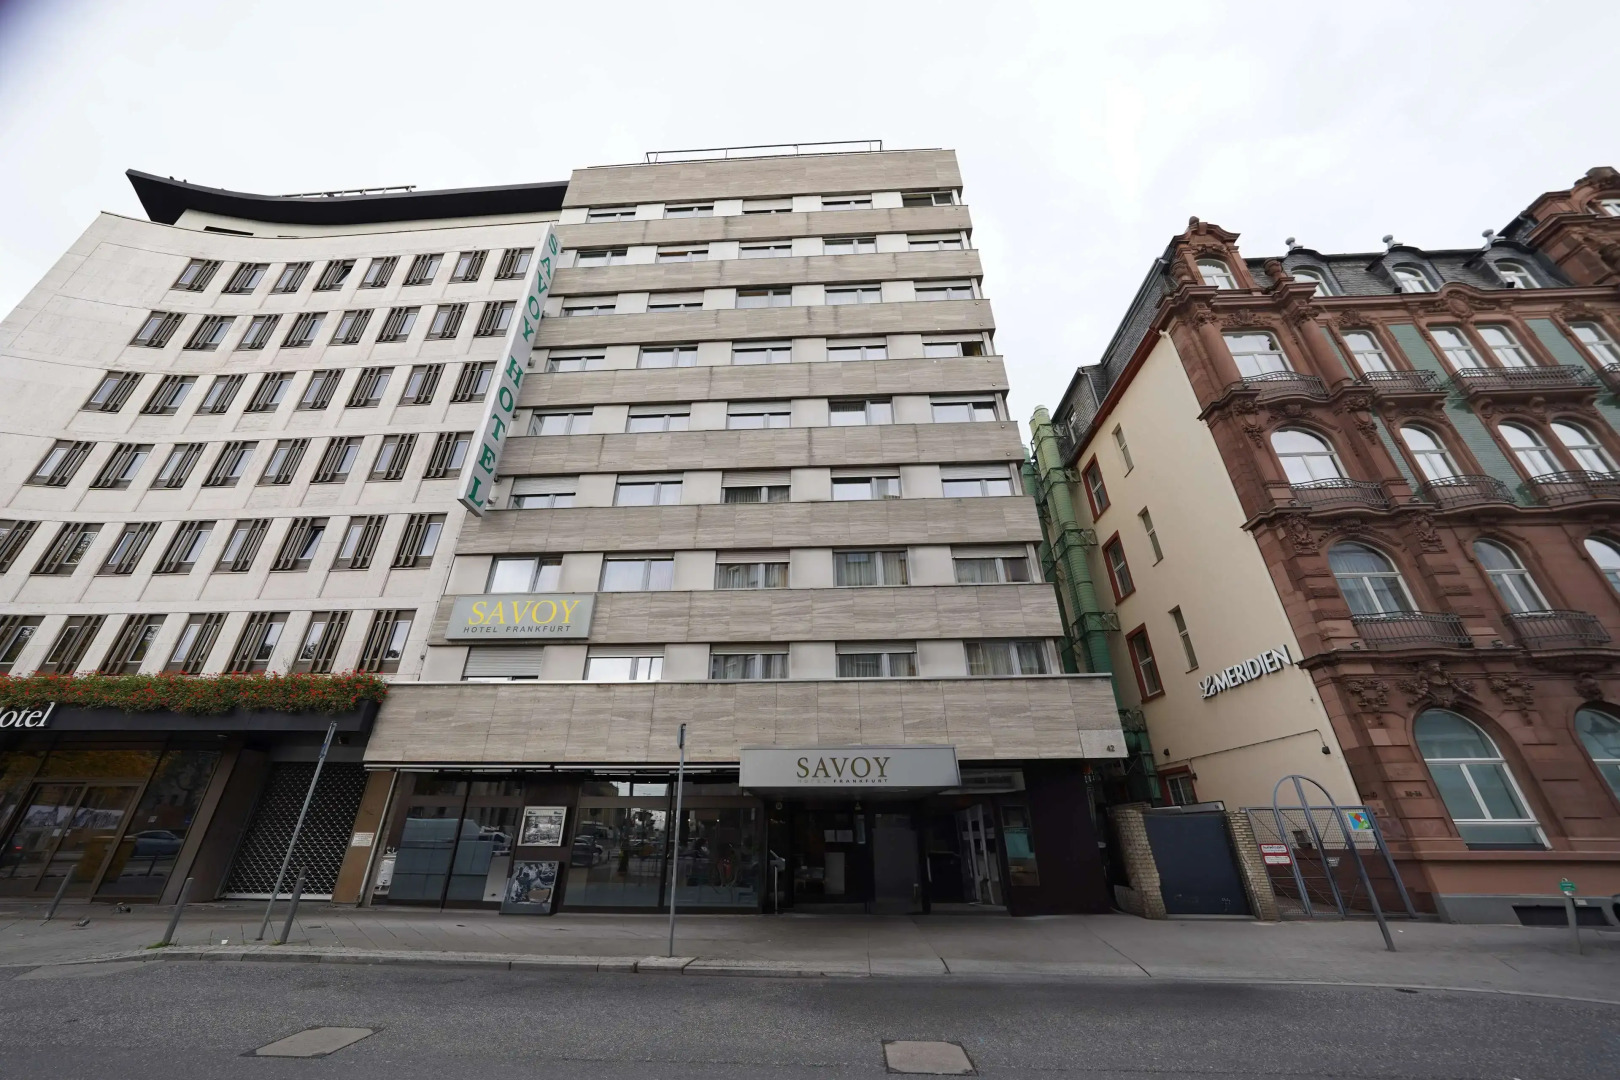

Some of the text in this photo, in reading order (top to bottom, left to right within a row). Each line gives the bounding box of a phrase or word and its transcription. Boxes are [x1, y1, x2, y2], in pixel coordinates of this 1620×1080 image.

[468, 233, 558, 508] SAVOY HOTEL
[468, 600, 580, 625] SAVOY
[463, 625, 572, 634] HOTEL FRANKFURT
[0, 701, 56, 728] otel
[1106, 744, 1116, 753] 42
[796, 756, 891, 779] SAVOY
